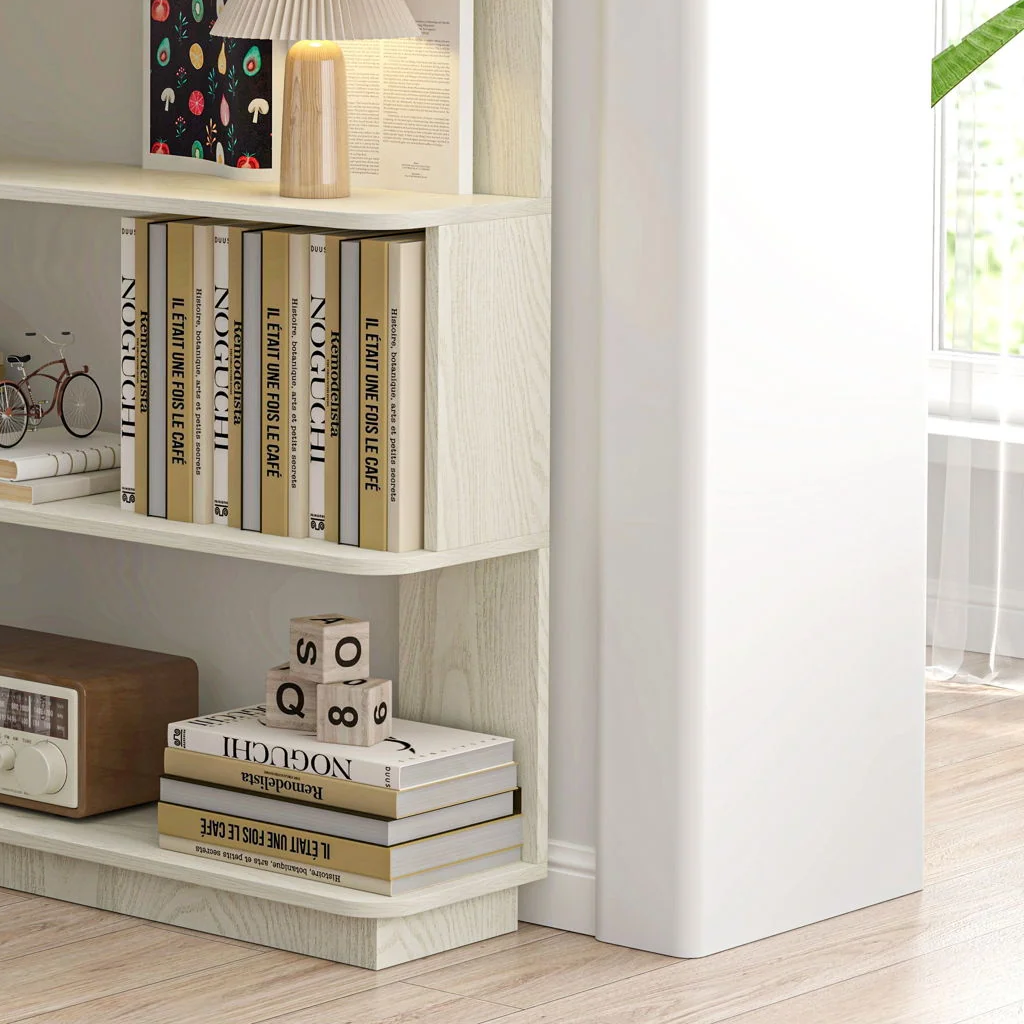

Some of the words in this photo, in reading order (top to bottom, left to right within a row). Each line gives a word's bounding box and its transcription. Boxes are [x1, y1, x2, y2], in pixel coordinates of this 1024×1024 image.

[365, 318, 378, 329] IL
[365, 334, 380, 371] ÉTAIT
[214, 286, 229, 450] NOGUCHI
[310, 295, 326, 463] NOGUCHI
[365, 375, 378, 401] UNE
[365, 405, 378, 433] FOIS
[365, 438, 378, 453] LE
[365, 456, 380, 491] CAFÉ
[297, 638, 316, 665] S
[277, 683, 305, 718] Q
[328, 706, 358, 727] 8
[223, 736, 352, 780] NOGUCHI
[241, 772, 323, 800] Remodelista
[201, 818, 225, 837] CAFÉ
[228, 824, 239, 841] LE
[243, 827, 264, 846] FOIS
[268, 832, 287, 851] UNE
[290, 836, 318, 860] ÉTAIT
[321, 842, 330, 860] IL
